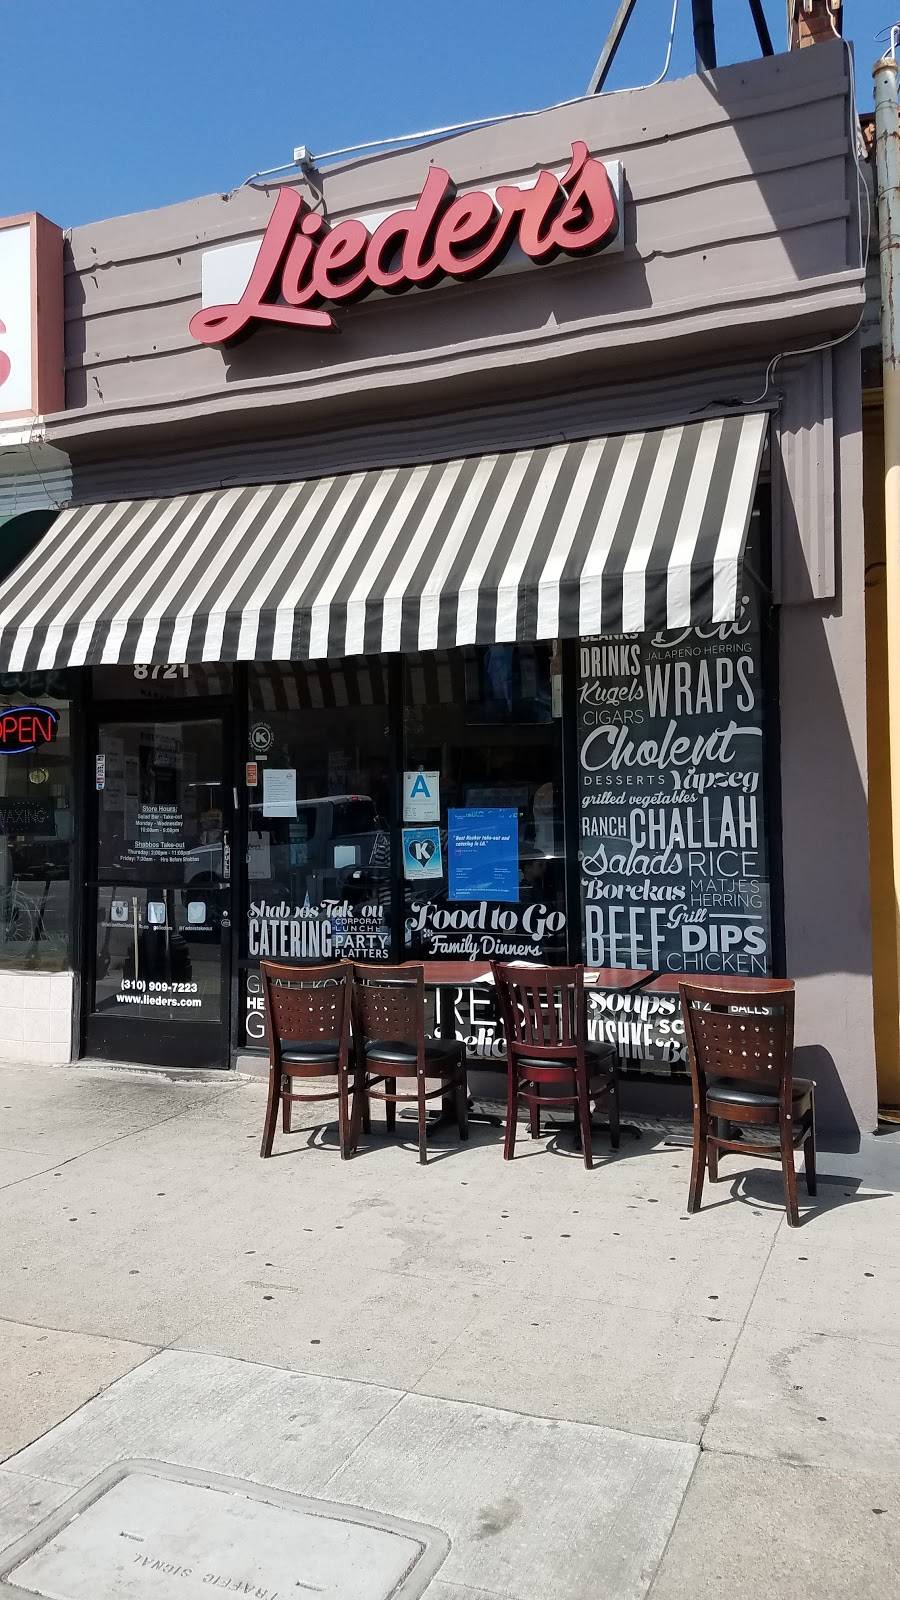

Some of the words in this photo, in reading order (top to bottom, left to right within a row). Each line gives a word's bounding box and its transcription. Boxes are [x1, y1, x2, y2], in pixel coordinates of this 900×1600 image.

[188, 140, 617, 346] Lieder's
[580, 645, 640, 678] DRINKS
[704, 643, 752, 655] HERRING
[577, 678, 644, 706] Kugels
[644, 656, 755, 718] WRAPS
[0, 716, 52, 743] PEN
[583, 709, 645, 726] CIGARS
[580, 719, 763, 772] Cholent
[410, 774, 431, 798] A
[584, 775, 666, 785] DESSERTS
[581, 792, 627, 808] grilled
[629, 790, 698, 808] vegetables
[582, 816, 627, 837] RANCH
[629, 795, 758, 850] CHALLAH
[415, 842, 431, 860] K
[581, 843, 684, 877] Salads
[688, 850, 761, 878] RICE
[580, 877, 686, 901] Borekas
[690, 878, 760, 894] MATJES
[690, 893, 763, 909] HERRING
[335, 917, 383, 925] CORPORAT
[405, 901, 488, 932] Food
[490, 904, 519, 931] to
[522, 903, 567, 941] Go
[667, 903, 708, 930] Grill
[249, 918, 332, 958] CATERING
[335, 934, 389, 949] PARTY
[429, 934, 480, 961] Family
[480, 935, 543, 956] Dinners
[585, 904, 666, 971] BEEF
[681, 924, 767, 955] DIPS
[334, 948, 389, 959] PLATTERS
[666, 953, 768, 974] CHICKEN
[121, 979, 146, 992] (310)
[148, 982, 198, 993] 909-7223
[116, 994, 202, 1007] www.lieders.com
[587, 991, 676, 1021] Soups
[132, 1552, 193, 1577] SIGNAL
